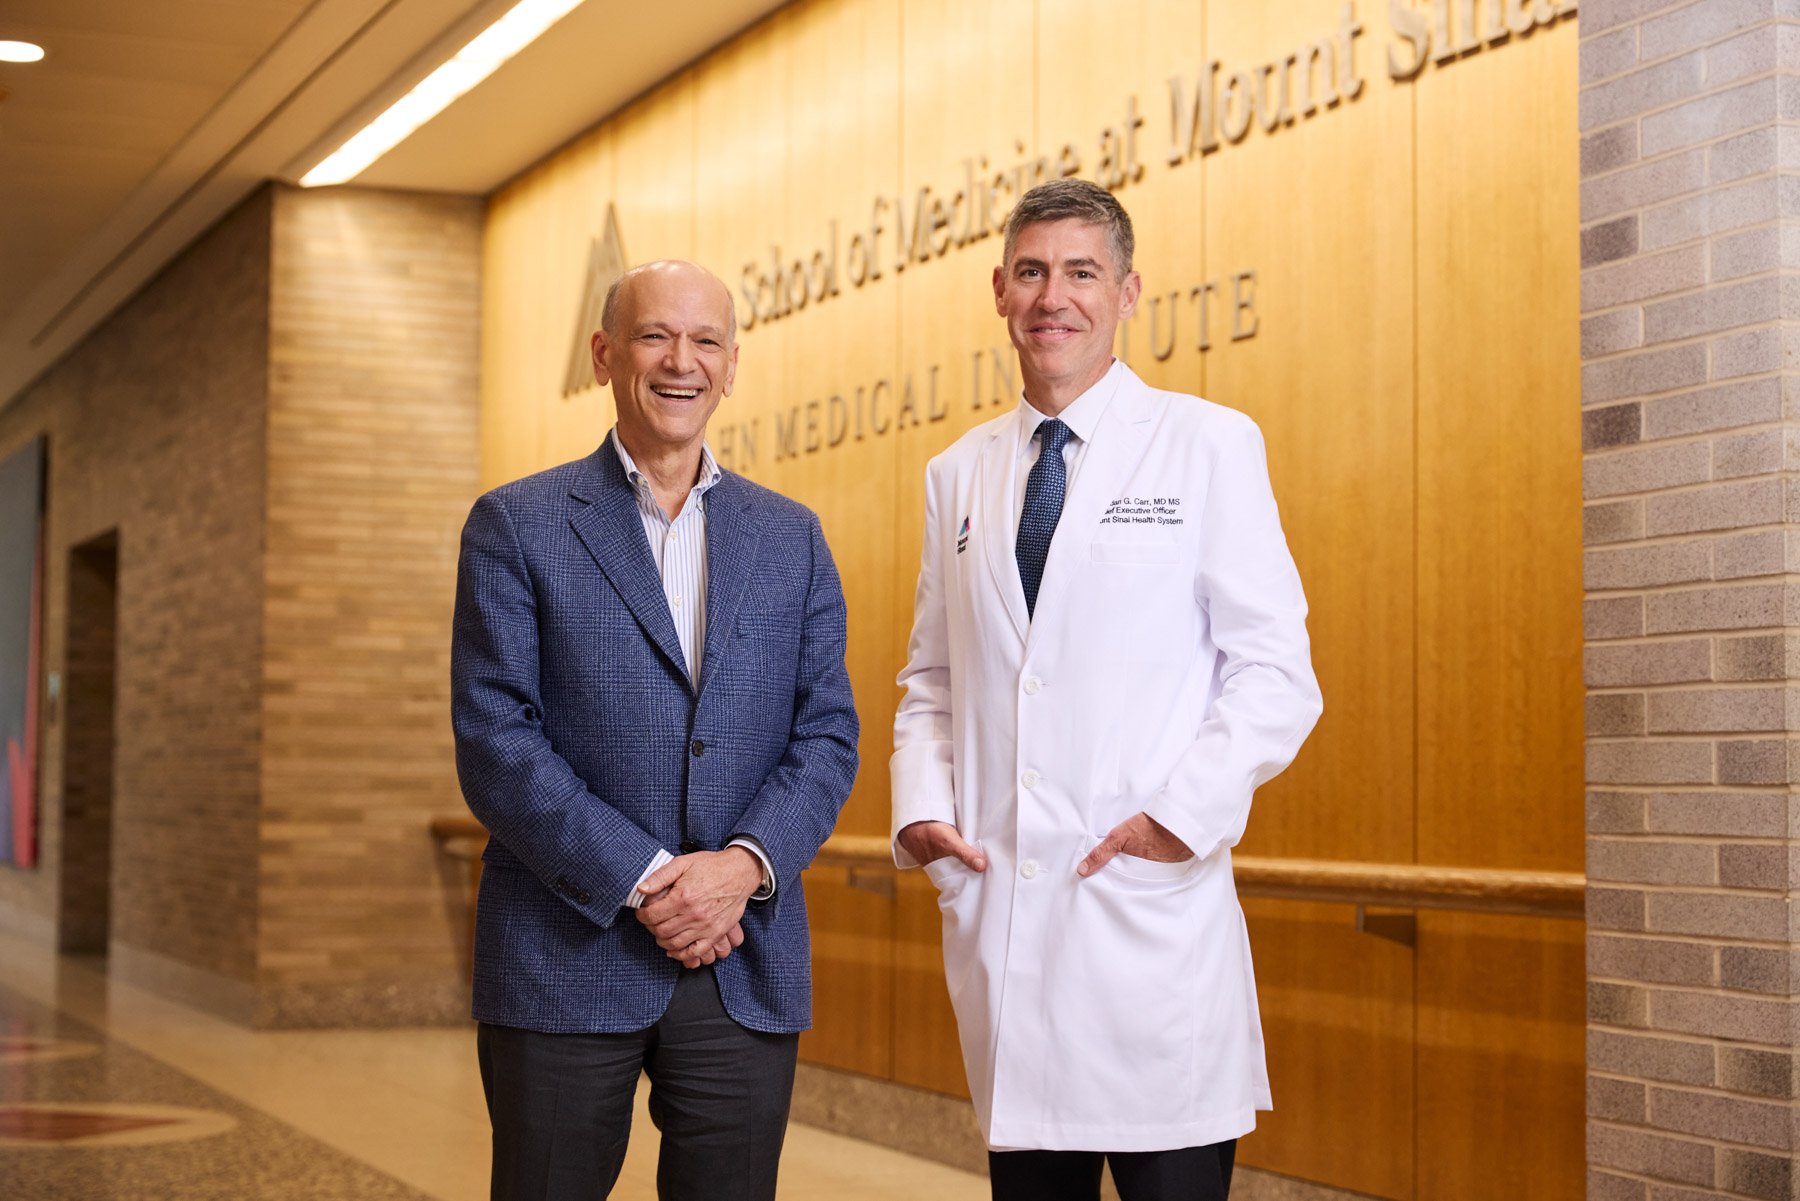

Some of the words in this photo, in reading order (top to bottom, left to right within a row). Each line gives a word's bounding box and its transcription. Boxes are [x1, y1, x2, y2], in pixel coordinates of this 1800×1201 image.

[739, 216, 841, 332] School
[848, 195, 890, 288] of
[1095, 95, 1145, 192] at
[1166, 0, 1364, 168] Mount
[1387, 0, 1577, 86] Sina
[774, 364, 949, 462] MEDICAL
[1123, 497, 1131, 505] G.
[1134, 497, 1152, 506] Carr,
[1116, 506, 1151, 514] Executive
[1152, 506, 1176, 515] Officer
[1112, 515, 1130, 524] Sinai
[1132, 516, 1155, 524] Health
[1157, 516, 1184, 526] System
